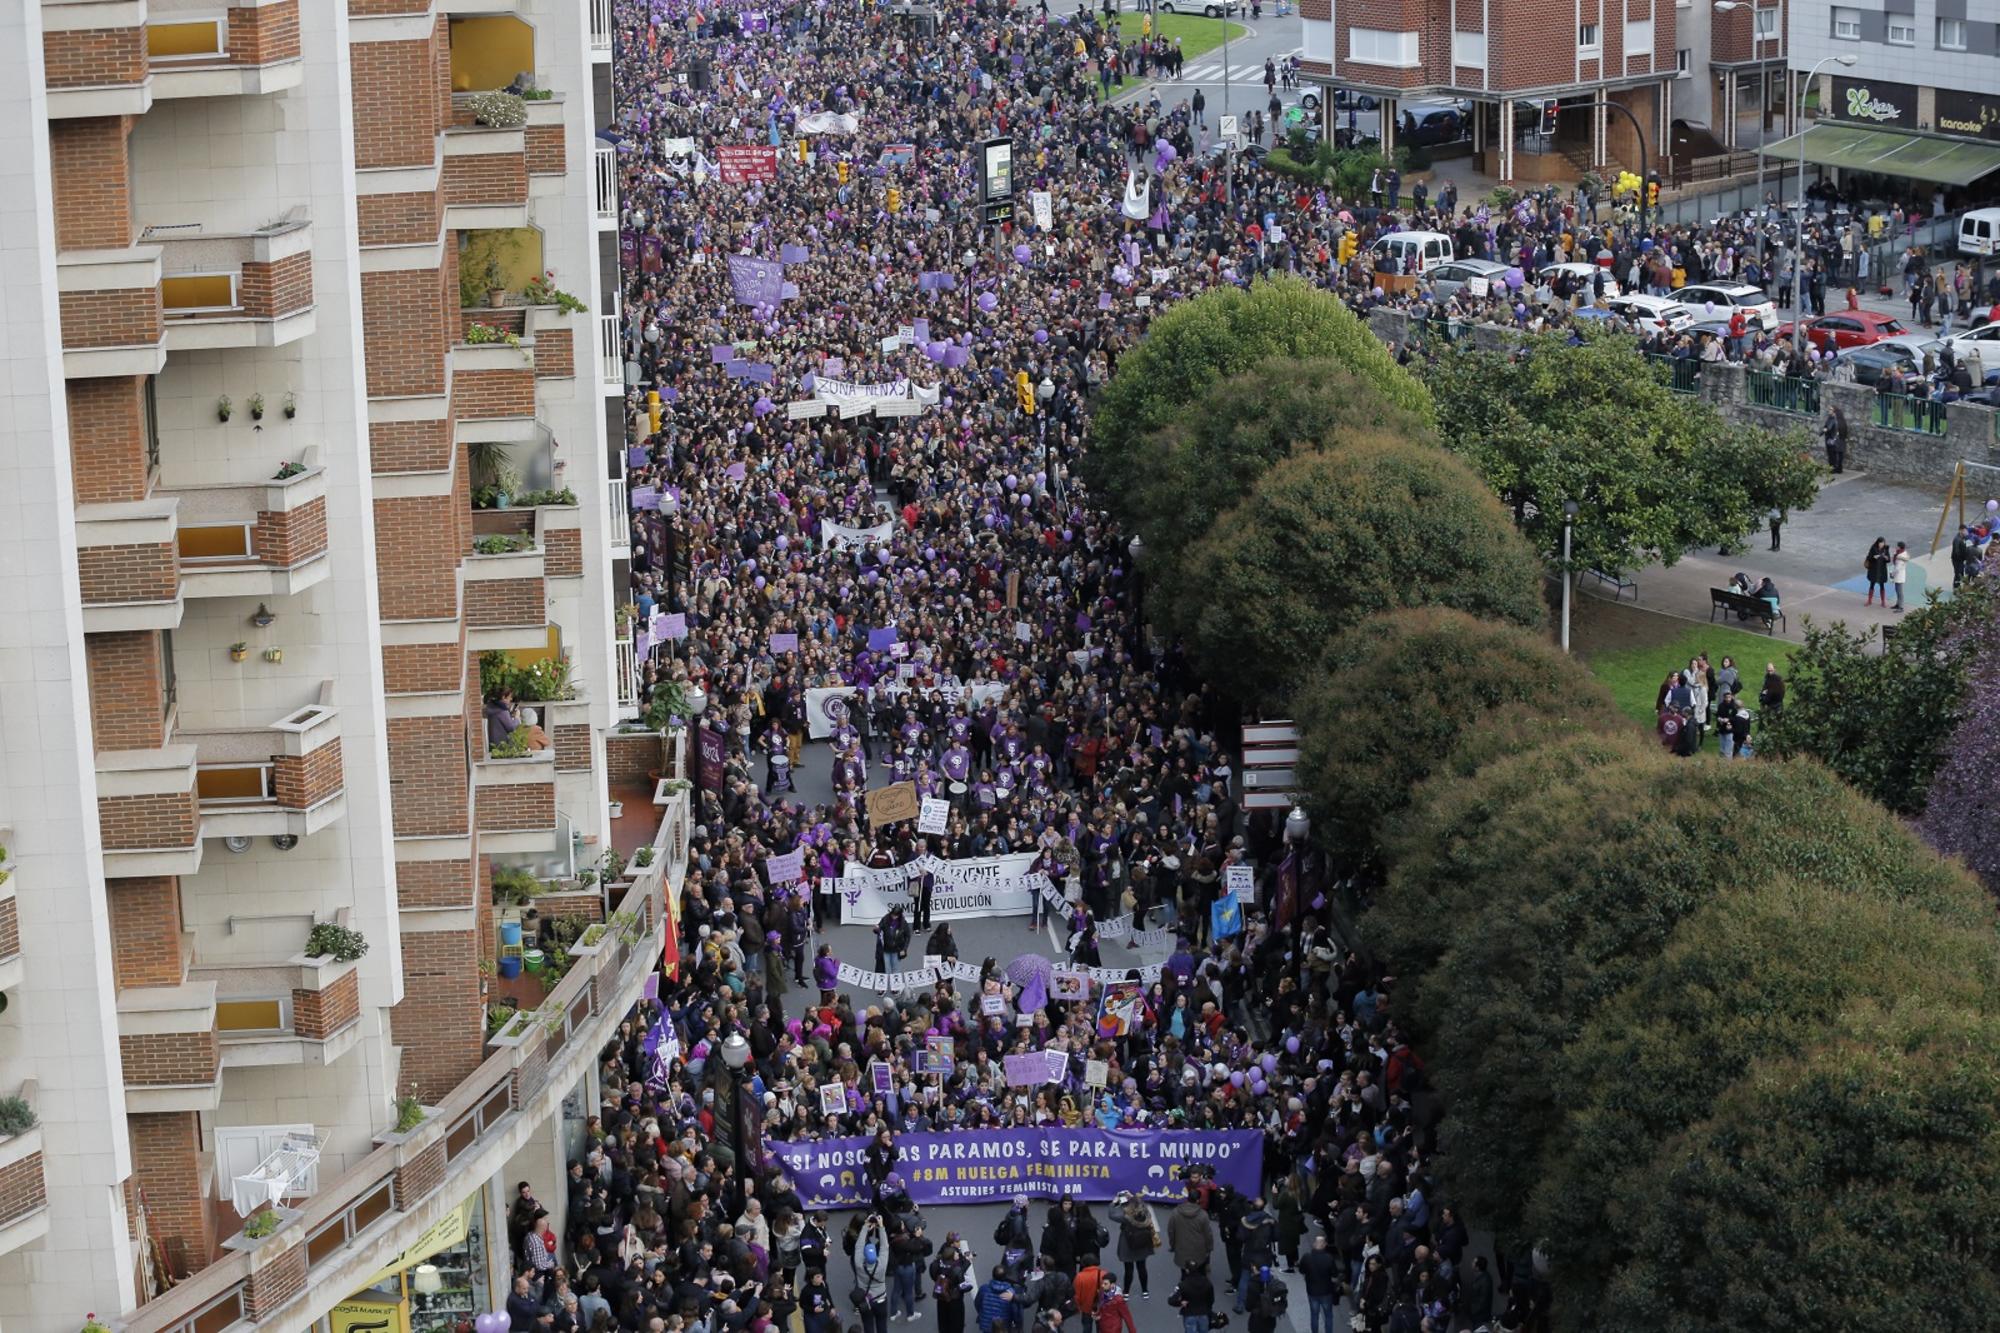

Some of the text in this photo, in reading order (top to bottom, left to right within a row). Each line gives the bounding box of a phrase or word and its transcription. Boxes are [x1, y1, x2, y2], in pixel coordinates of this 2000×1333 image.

[1940, 117, 1982, 133] karaoke
[817, 378, 856, 395] ZONA
[930, 893, 992, 911] REVOLUCIÓN
[819, 1146, 920, 1169] NOSOAS
[929, 1140, 1032, 1159] PARAMOS,
[1040, 1140, 1060, 1157] SE
[1069, 1141, 1121, 1158] PARA
[1130, 1142, 1150, 1159] EL
[913, 1163, 1110, 1182] #8M HUELGA FEMINISTA
[940, 1181, 1082, 1197] ASTURIES FEMINISTA 8M
